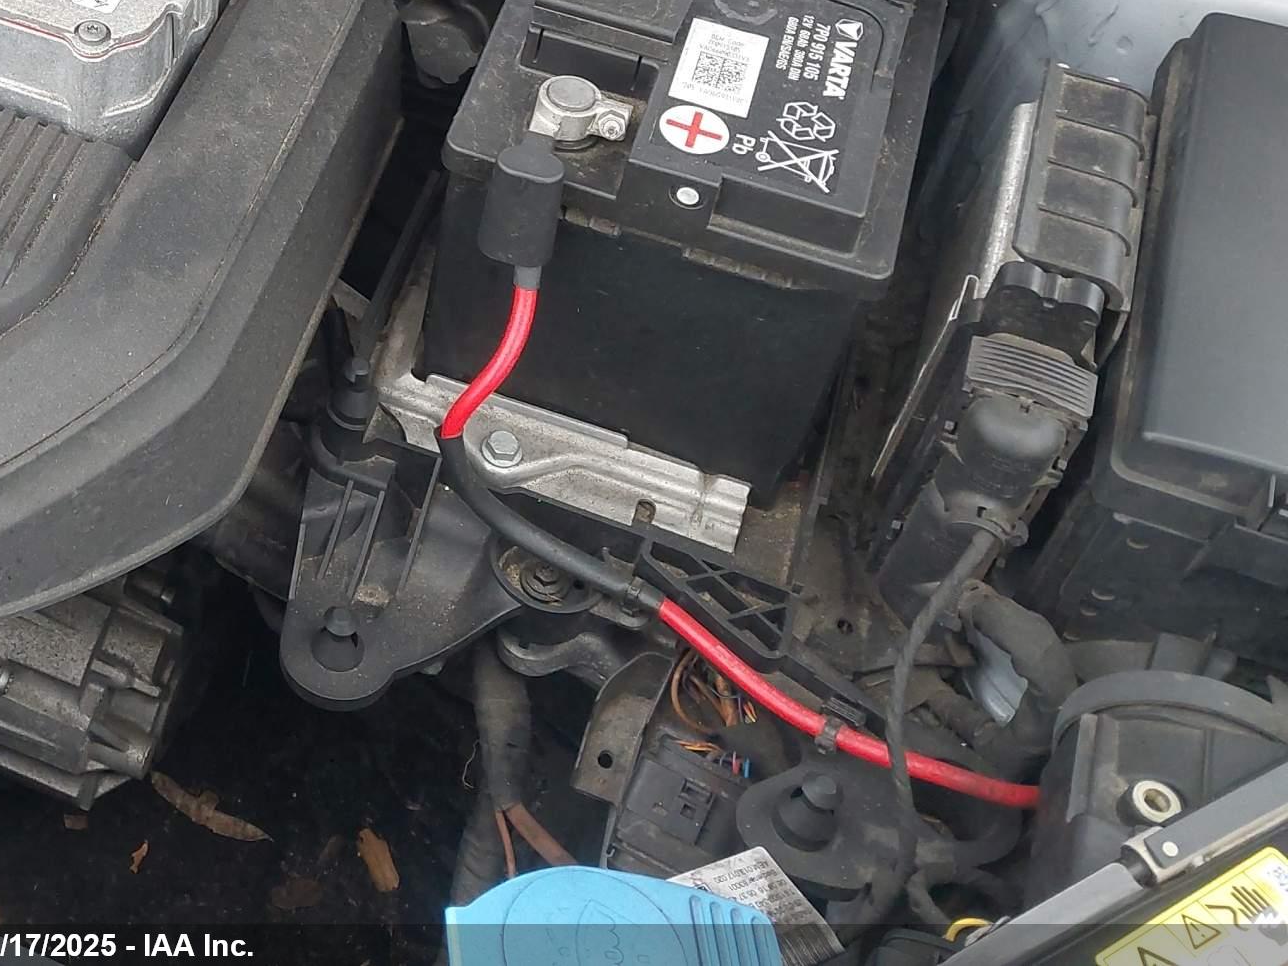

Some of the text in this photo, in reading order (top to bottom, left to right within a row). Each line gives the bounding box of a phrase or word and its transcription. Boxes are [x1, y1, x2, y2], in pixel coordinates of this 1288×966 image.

[802, 15, 815, 29] 12V
[804, 23, 831, 81] 7P0 915 105
[823, 41, 858, 98] VARTA
[733, 134, 756, 155] Pb
